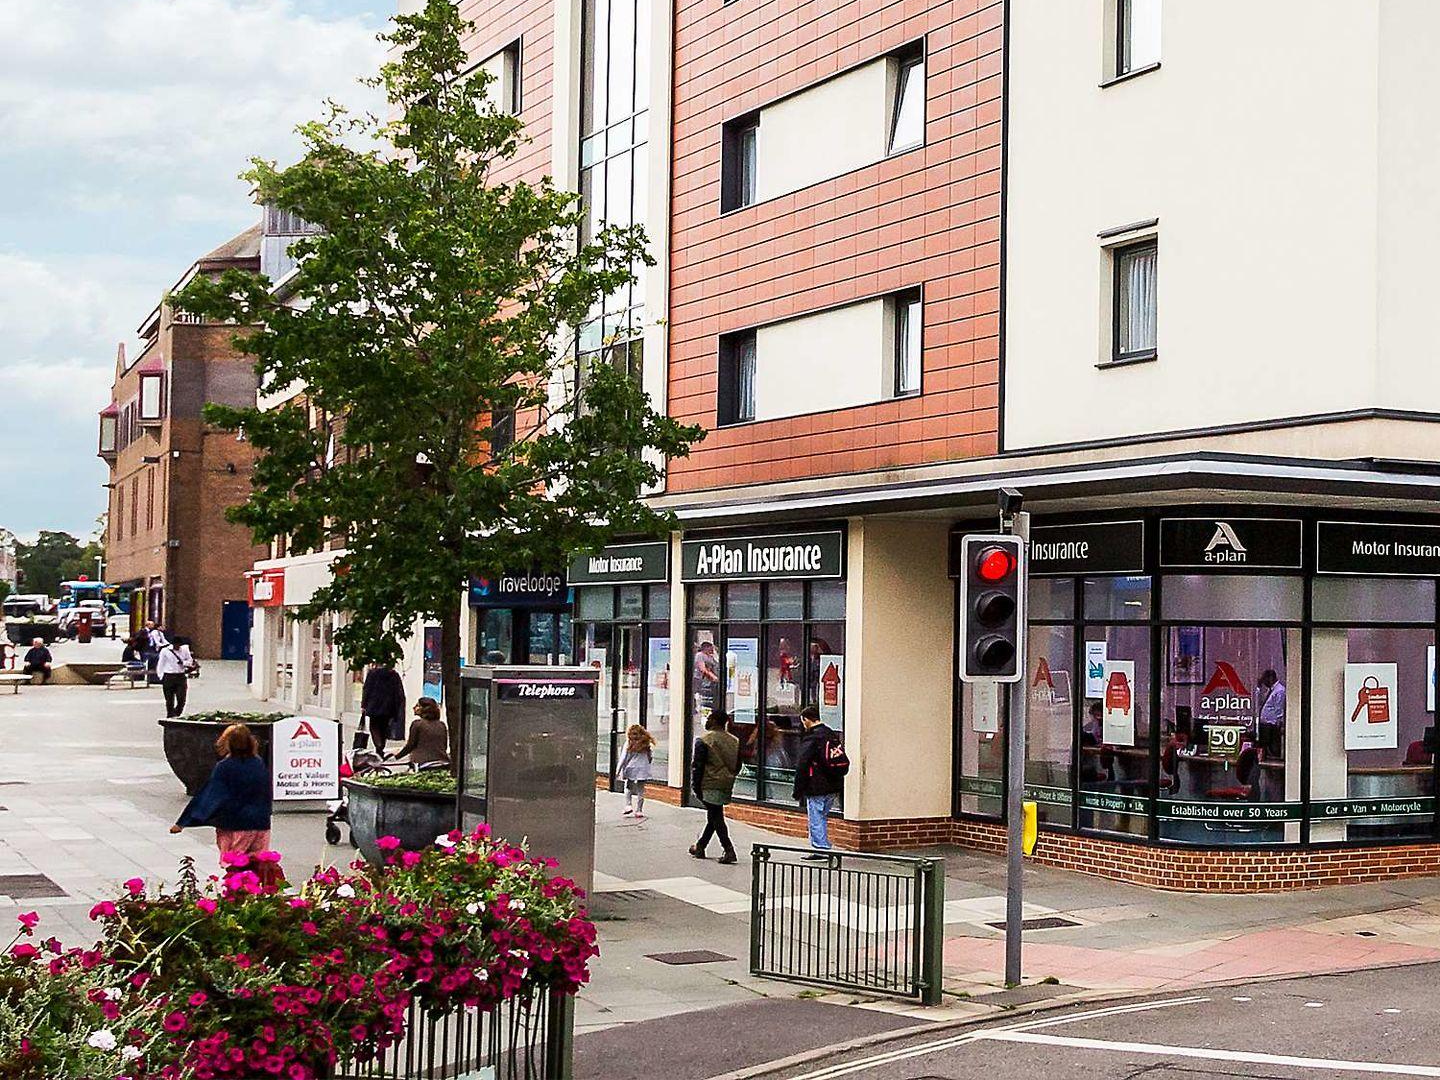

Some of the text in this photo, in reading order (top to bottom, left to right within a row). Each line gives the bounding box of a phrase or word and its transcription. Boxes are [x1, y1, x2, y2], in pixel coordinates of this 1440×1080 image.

[1031, 539, 1089, 561] Insurance
[1351, 540, 1391, 557] Motor
[588, 555, 643, 574] Motor Insurance
[696, 542, 822, 575] A-Plan Insurance
[1204, 550, 1247, 564] a-plan
[517, 683, 576, 699] Telephone
[1200, 693, 1252, 712] a-plan
[1210, 728, 1238, 746] 50
[290, 758, 322, 768] OPEN
[277, 771, 331, 780] Great Value
[1171, 805, 1289, 818] Established over 50 Years
[1325, 801, 1422, 815] Car Van Motorcycle
